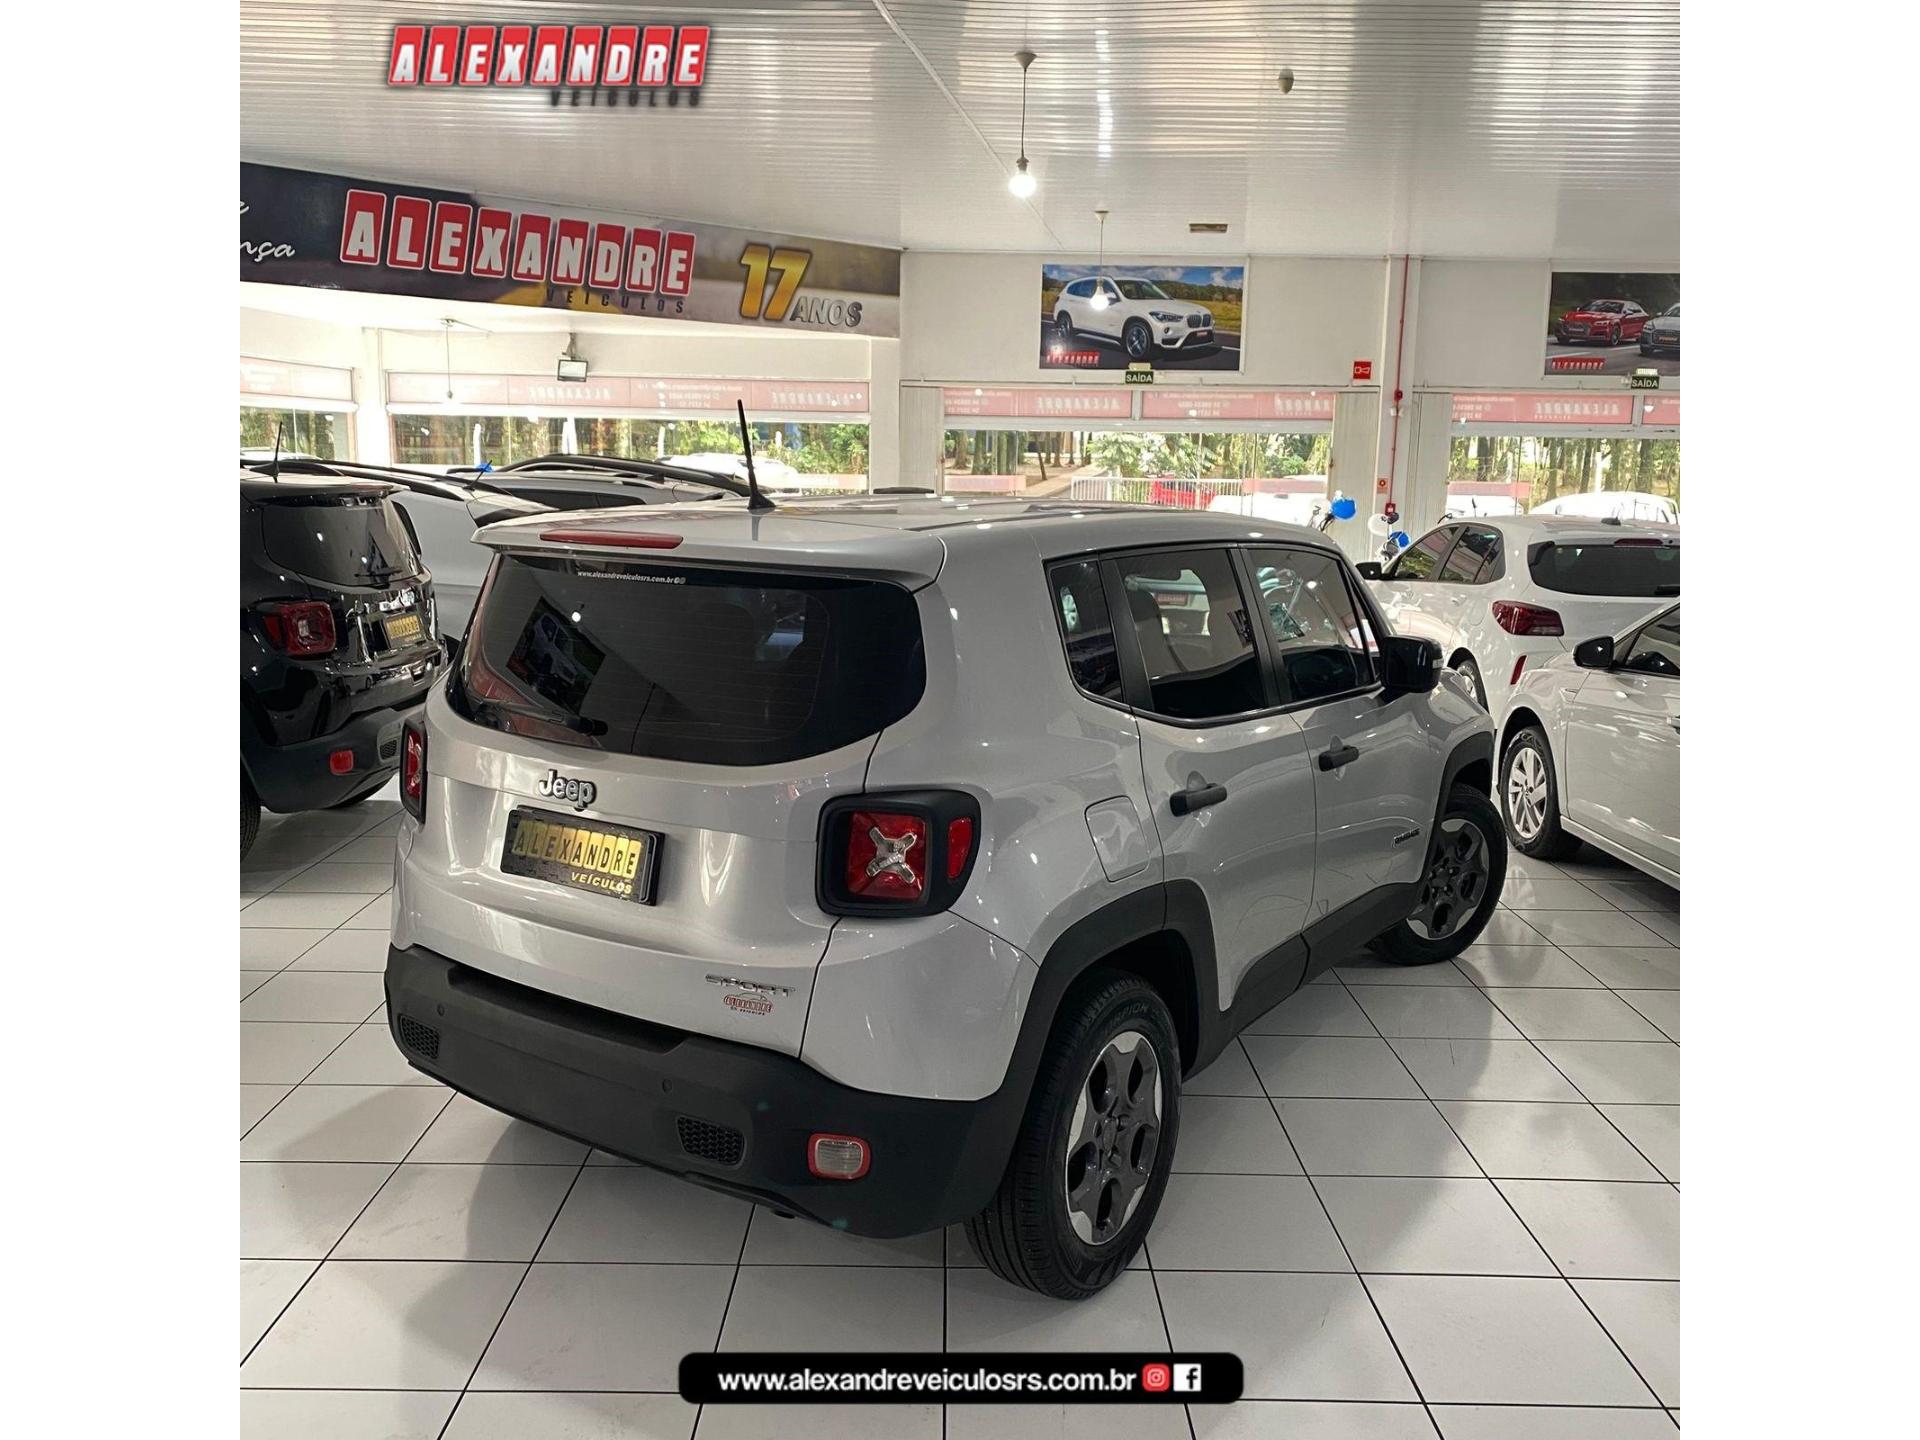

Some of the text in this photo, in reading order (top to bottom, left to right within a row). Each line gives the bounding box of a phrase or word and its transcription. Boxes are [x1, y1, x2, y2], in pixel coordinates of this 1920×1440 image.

[345, 208, 688, 291] ALEXANDRE
[739, 243, 862, 327] 17 ANOS
[538, 768, 597, 809] Jeep
[514, 828, 639, 877] ALEXANDRE
[571, 871, 634, 895] VEÍCULOS
